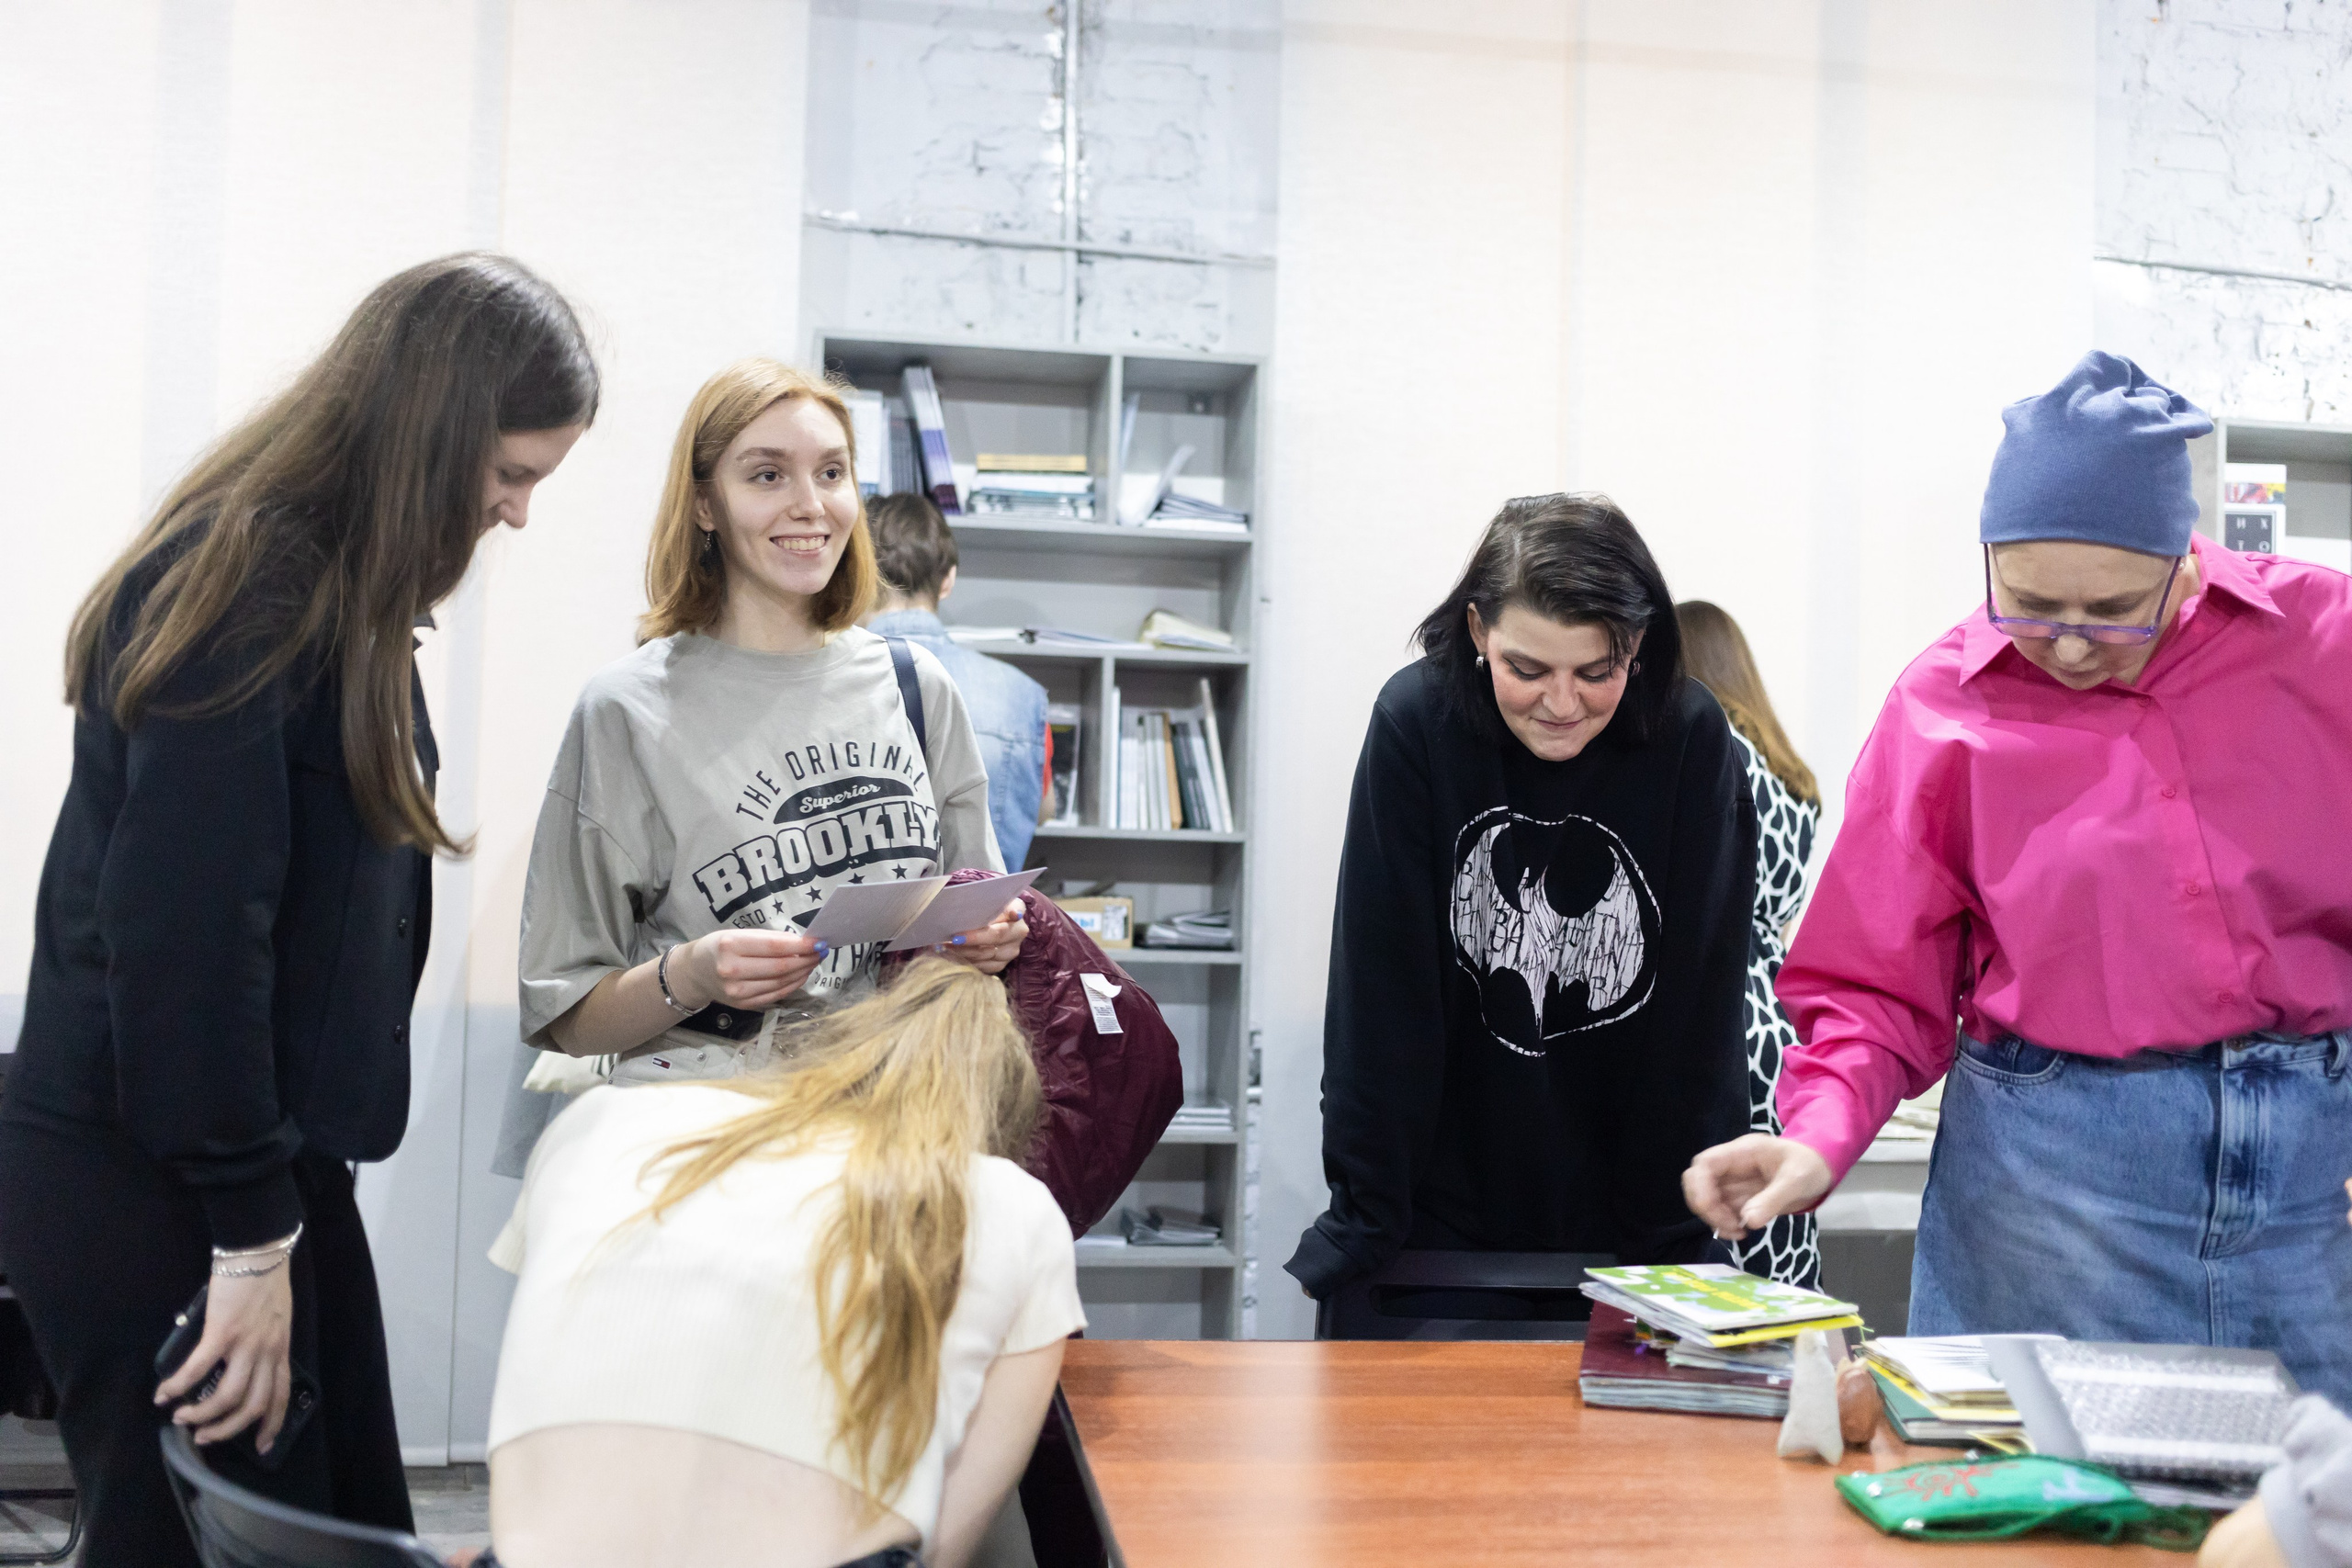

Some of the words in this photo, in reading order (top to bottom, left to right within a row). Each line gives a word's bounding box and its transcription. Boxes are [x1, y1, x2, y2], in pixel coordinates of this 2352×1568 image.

[736, 770, 781, 821] THE
[799, 783, 881, 813] Superior
[693, 801, 942, 921] BROOKLY
